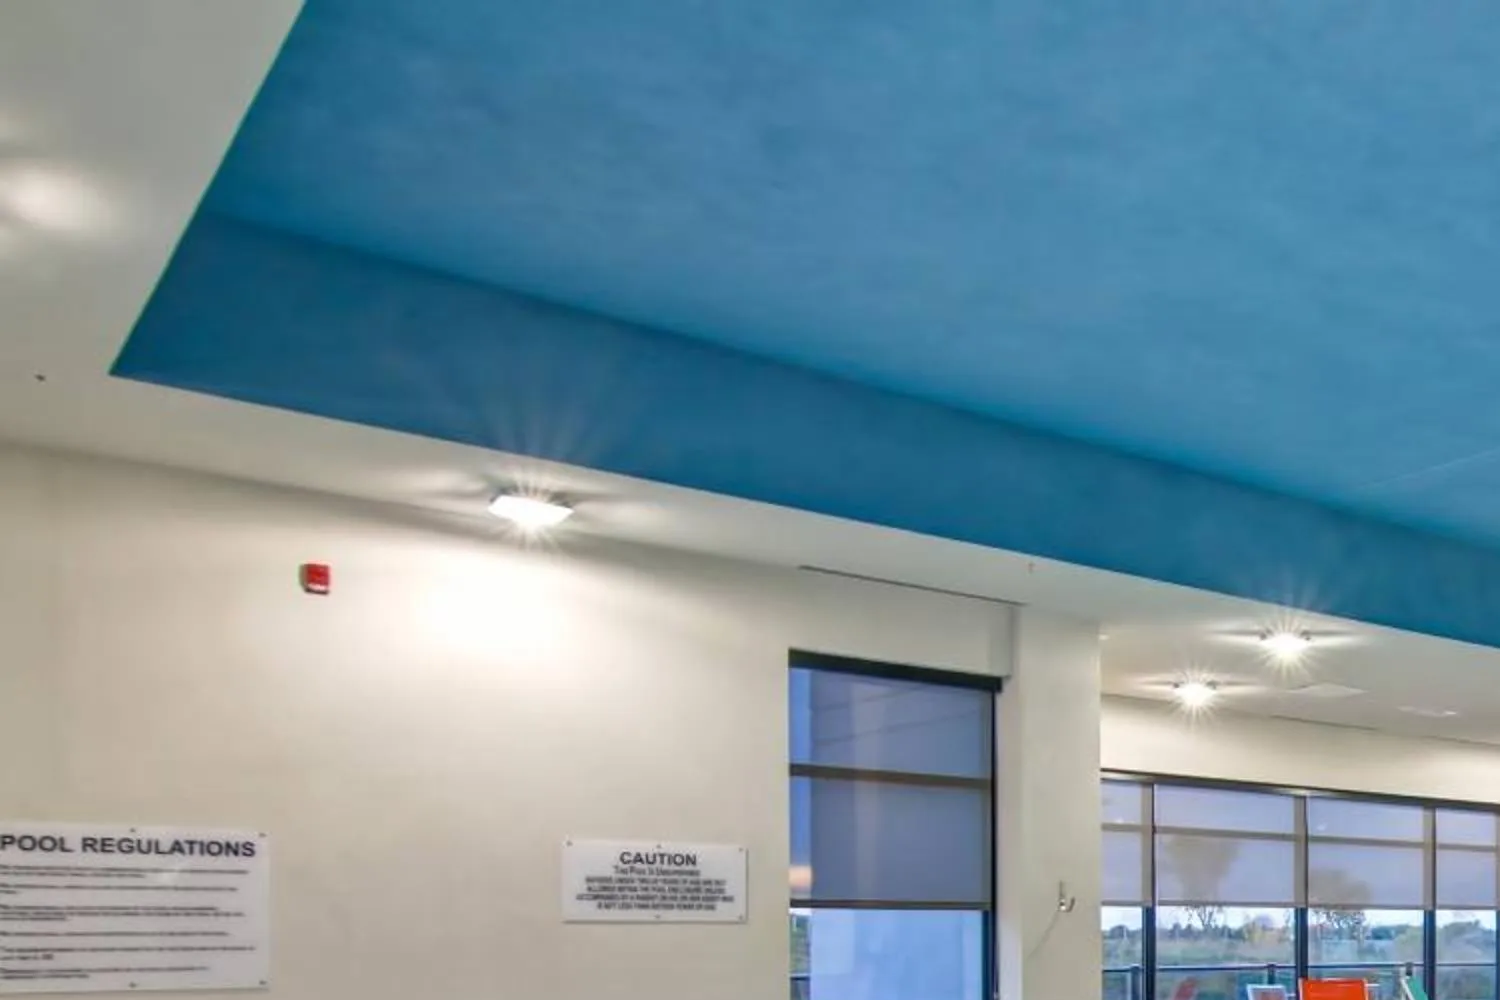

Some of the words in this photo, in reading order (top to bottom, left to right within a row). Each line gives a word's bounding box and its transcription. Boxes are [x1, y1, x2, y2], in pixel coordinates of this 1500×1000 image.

[0, 834, 75, 853] POOL
[81, 837, 257, 858] REGULATIONS
[619, 851, 698, 866] CAUTION
